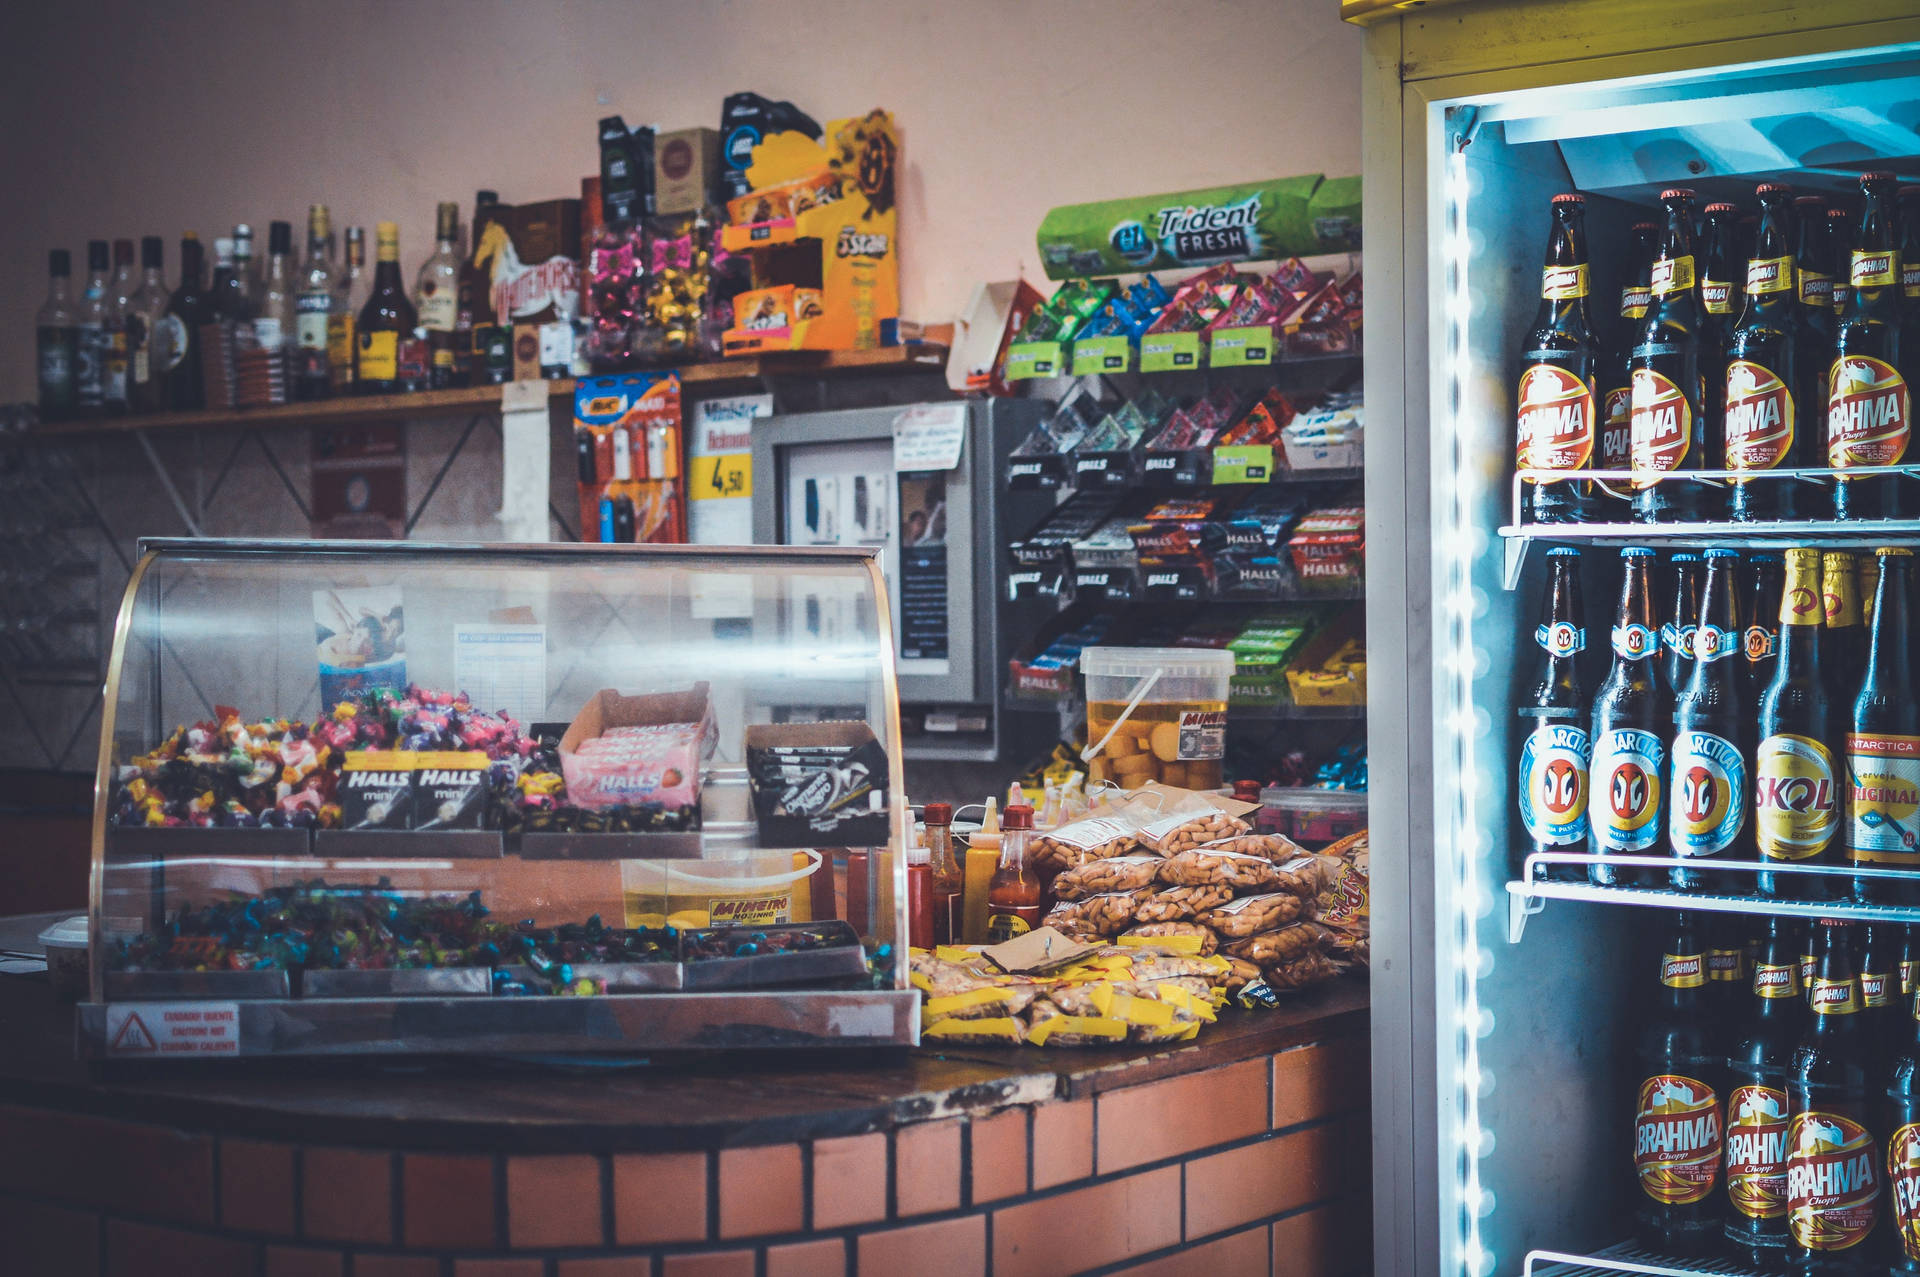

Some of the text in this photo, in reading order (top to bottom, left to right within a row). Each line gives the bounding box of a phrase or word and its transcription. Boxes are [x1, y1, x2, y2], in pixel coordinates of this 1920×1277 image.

[1159, 202, 1258, 237] Trident
[1180, 231, 1242, 253] FRESH
[1227, 534, 1263, 545] HALLS
[1240, 569, 1281, 581] HALLS
[1302, 563, 1348, 577] HALLS
[1231, 685, 1273, 697] HALLS
[348, 771, 410, 787] HALLS
[420, 769, 481, 787] HALLS
[599, 774, 659, 792] HALLS
[363, 789, 393, 801] mini
[434, 787, 464, 799] mini
[1756, 776, 1834, 814] SKOL
[1846, 782, 1919, 805] ORIGINAL
[713, 898, 787, 916] MINEIRO
[1667, 961, 1699, 977] BRAHMA
[1758, 971, 1789, 985] BRAHMA
[1637, 1112, 1719, 1157] BRAHMA
[1658, 1152, 1689, 1161] Chopp
[1744, 1165, 1774, 1174] Chopp
[1788, 1153, 1873, 1203] BRAHMA
[1808, 1196, 1840, 1206] Chopp
